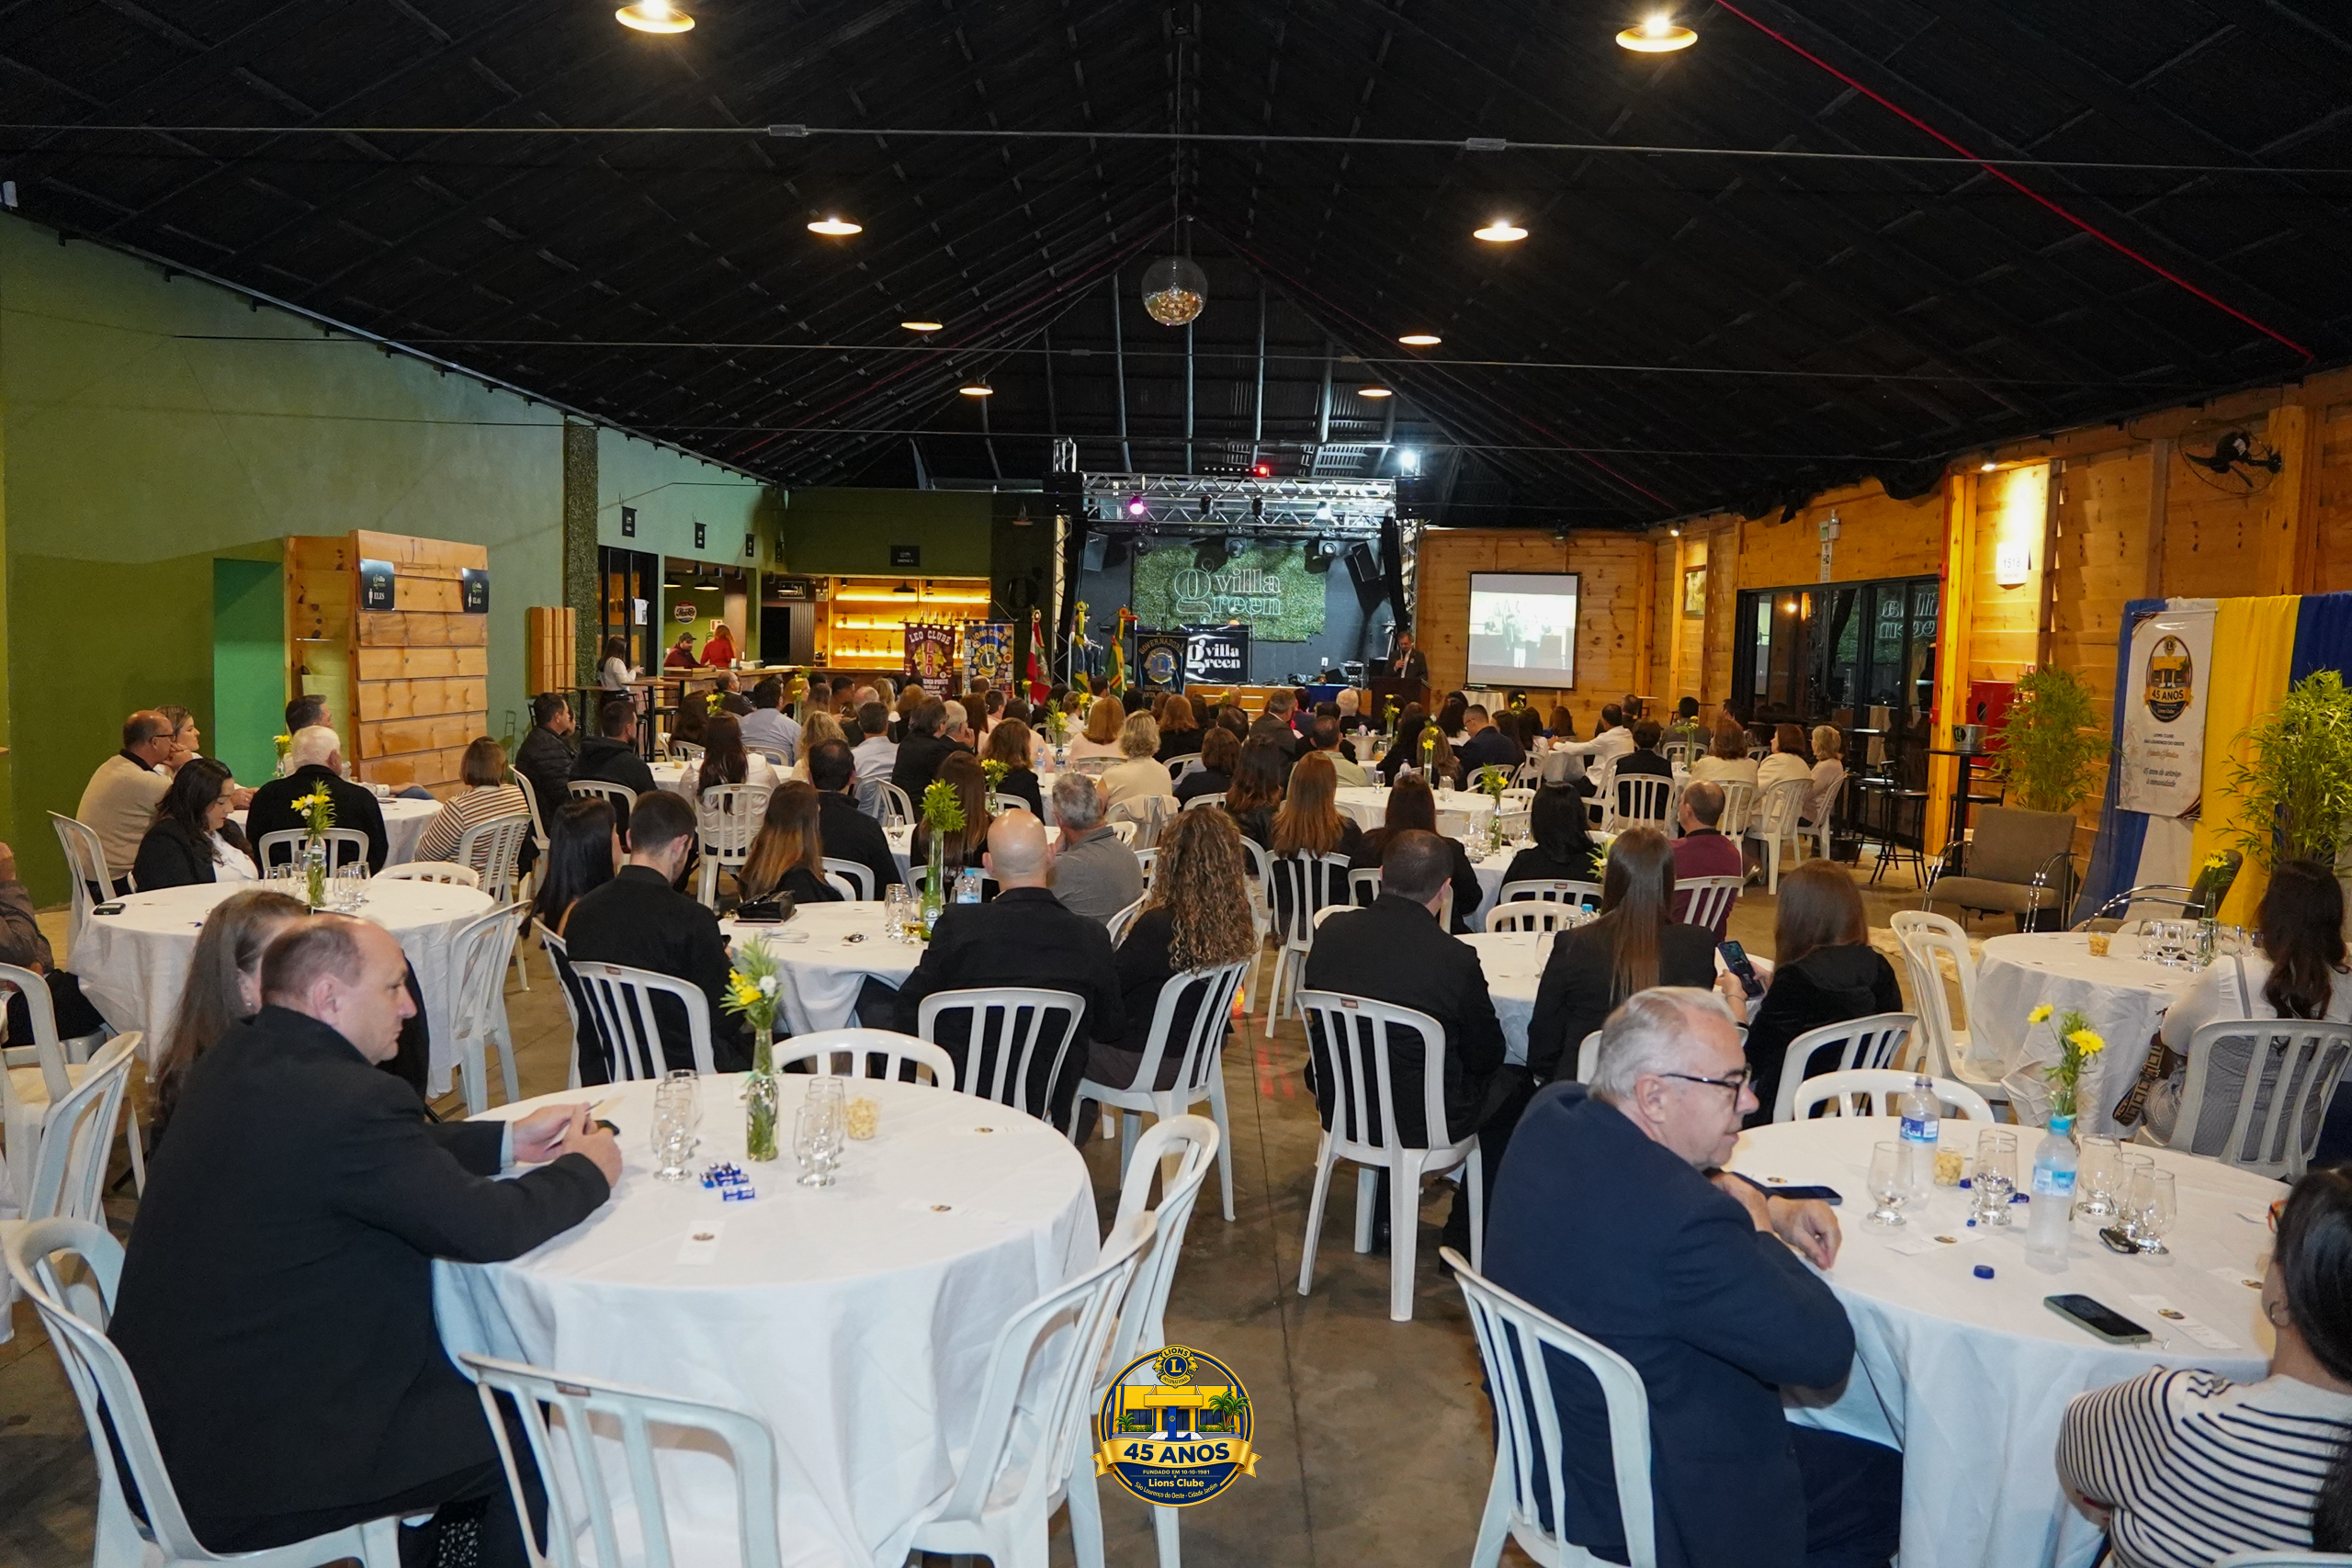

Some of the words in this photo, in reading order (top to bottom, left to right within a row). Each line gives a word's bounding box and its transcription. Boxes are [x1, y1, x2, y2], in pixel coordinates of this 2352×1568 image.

[1215, 568, 1281, 593] villa
[909, 631, 924, 643] LEO
[927, 630, 952, 645] CLUBE
[1205, 643, 1239, 658] villa
[2152, 689, 2161, 699] 45
[2162, 689, 2184, 701] ANOS
